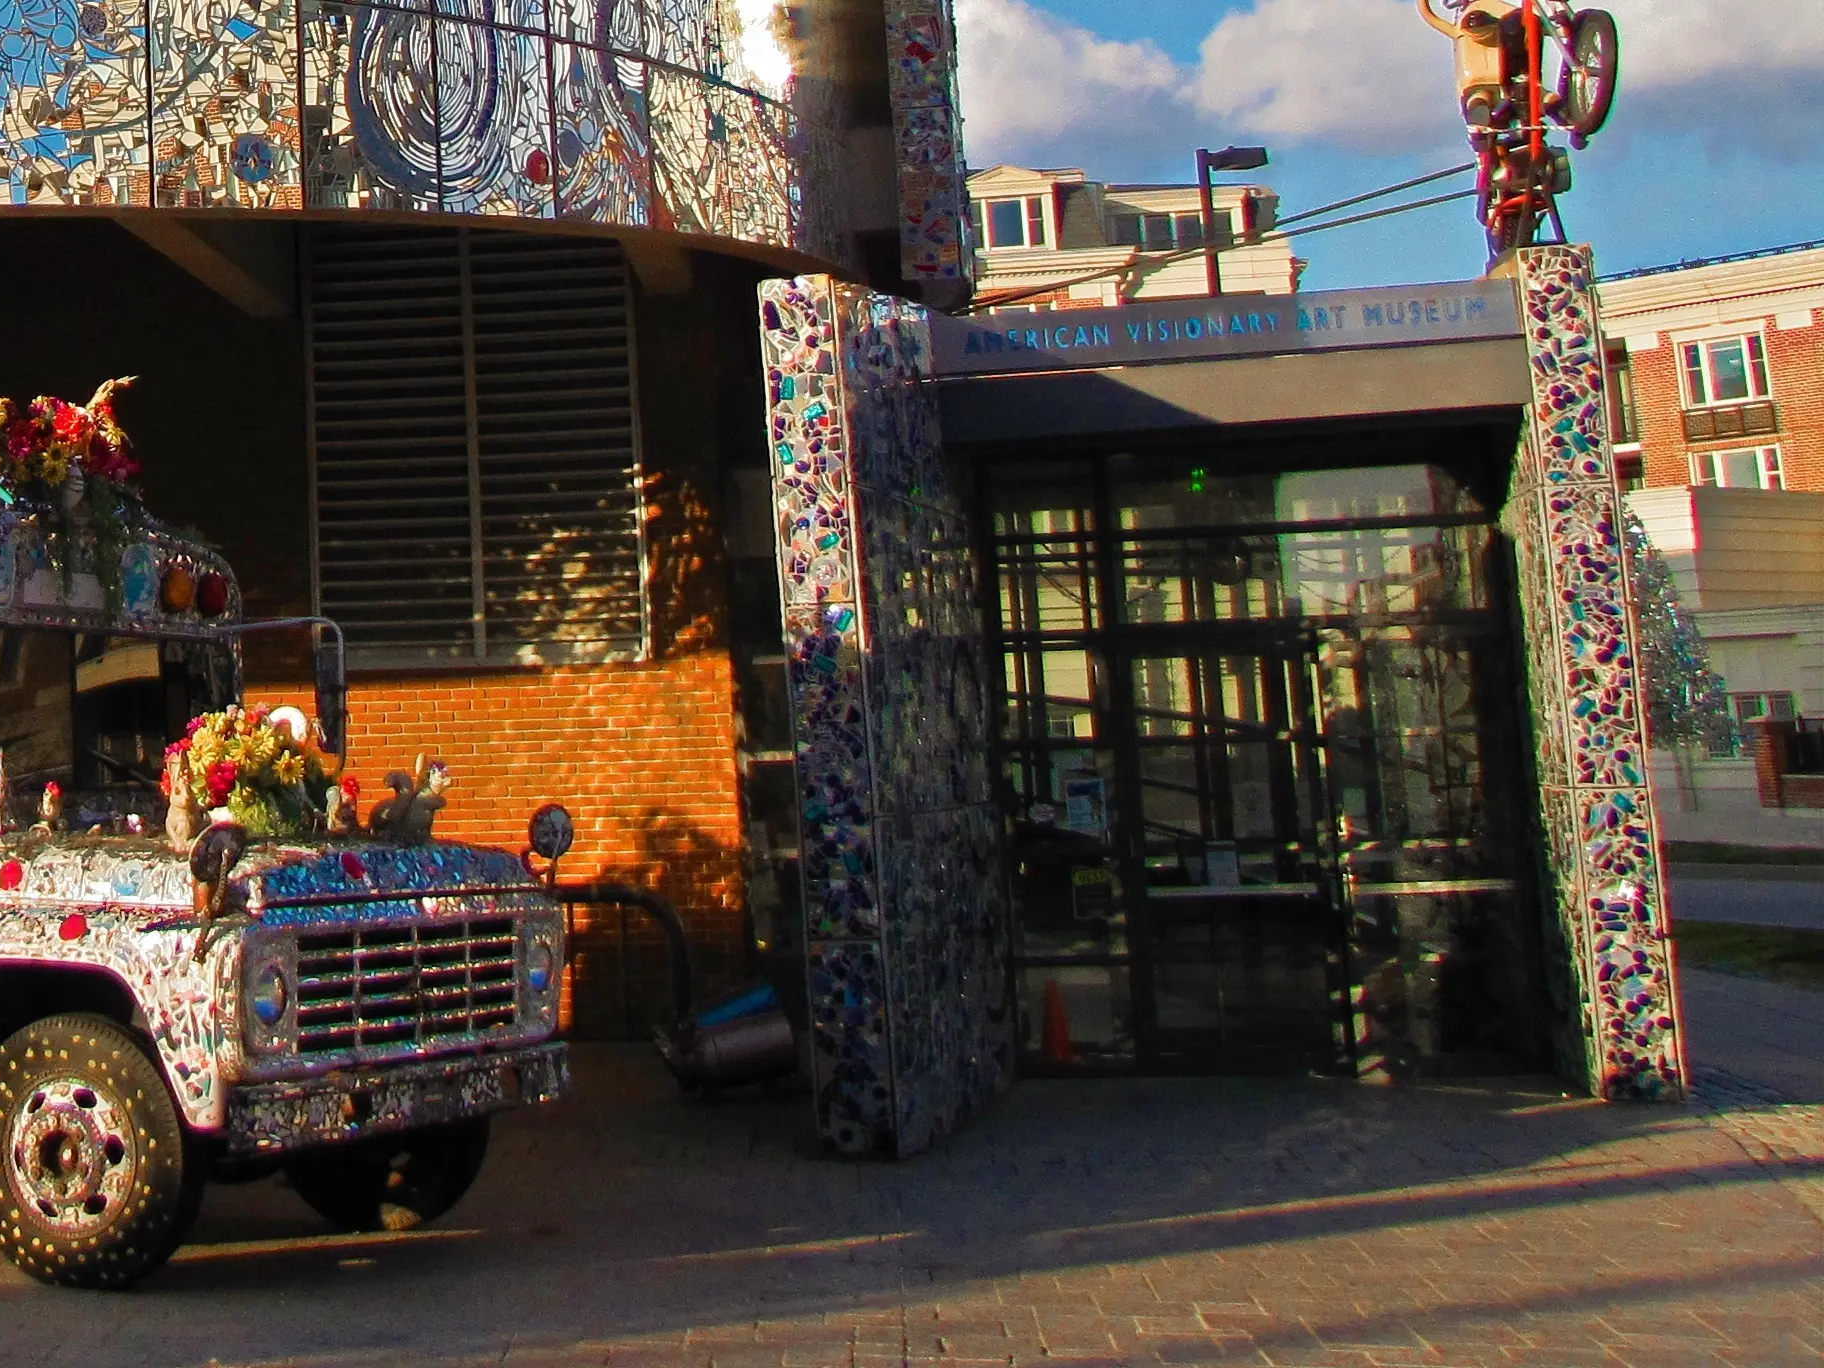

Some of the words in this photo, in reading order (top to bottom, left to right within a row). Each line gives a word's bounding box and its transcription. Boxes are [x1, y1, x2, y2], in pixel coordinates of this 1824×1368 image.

[965, 324, 1110, 353] AMERICAN
[1126, 311, 1280, 343] VISIONARY
[1296, 305, 1345, 331] ART
[1362, 296, 1486, 326] MUSEUM
